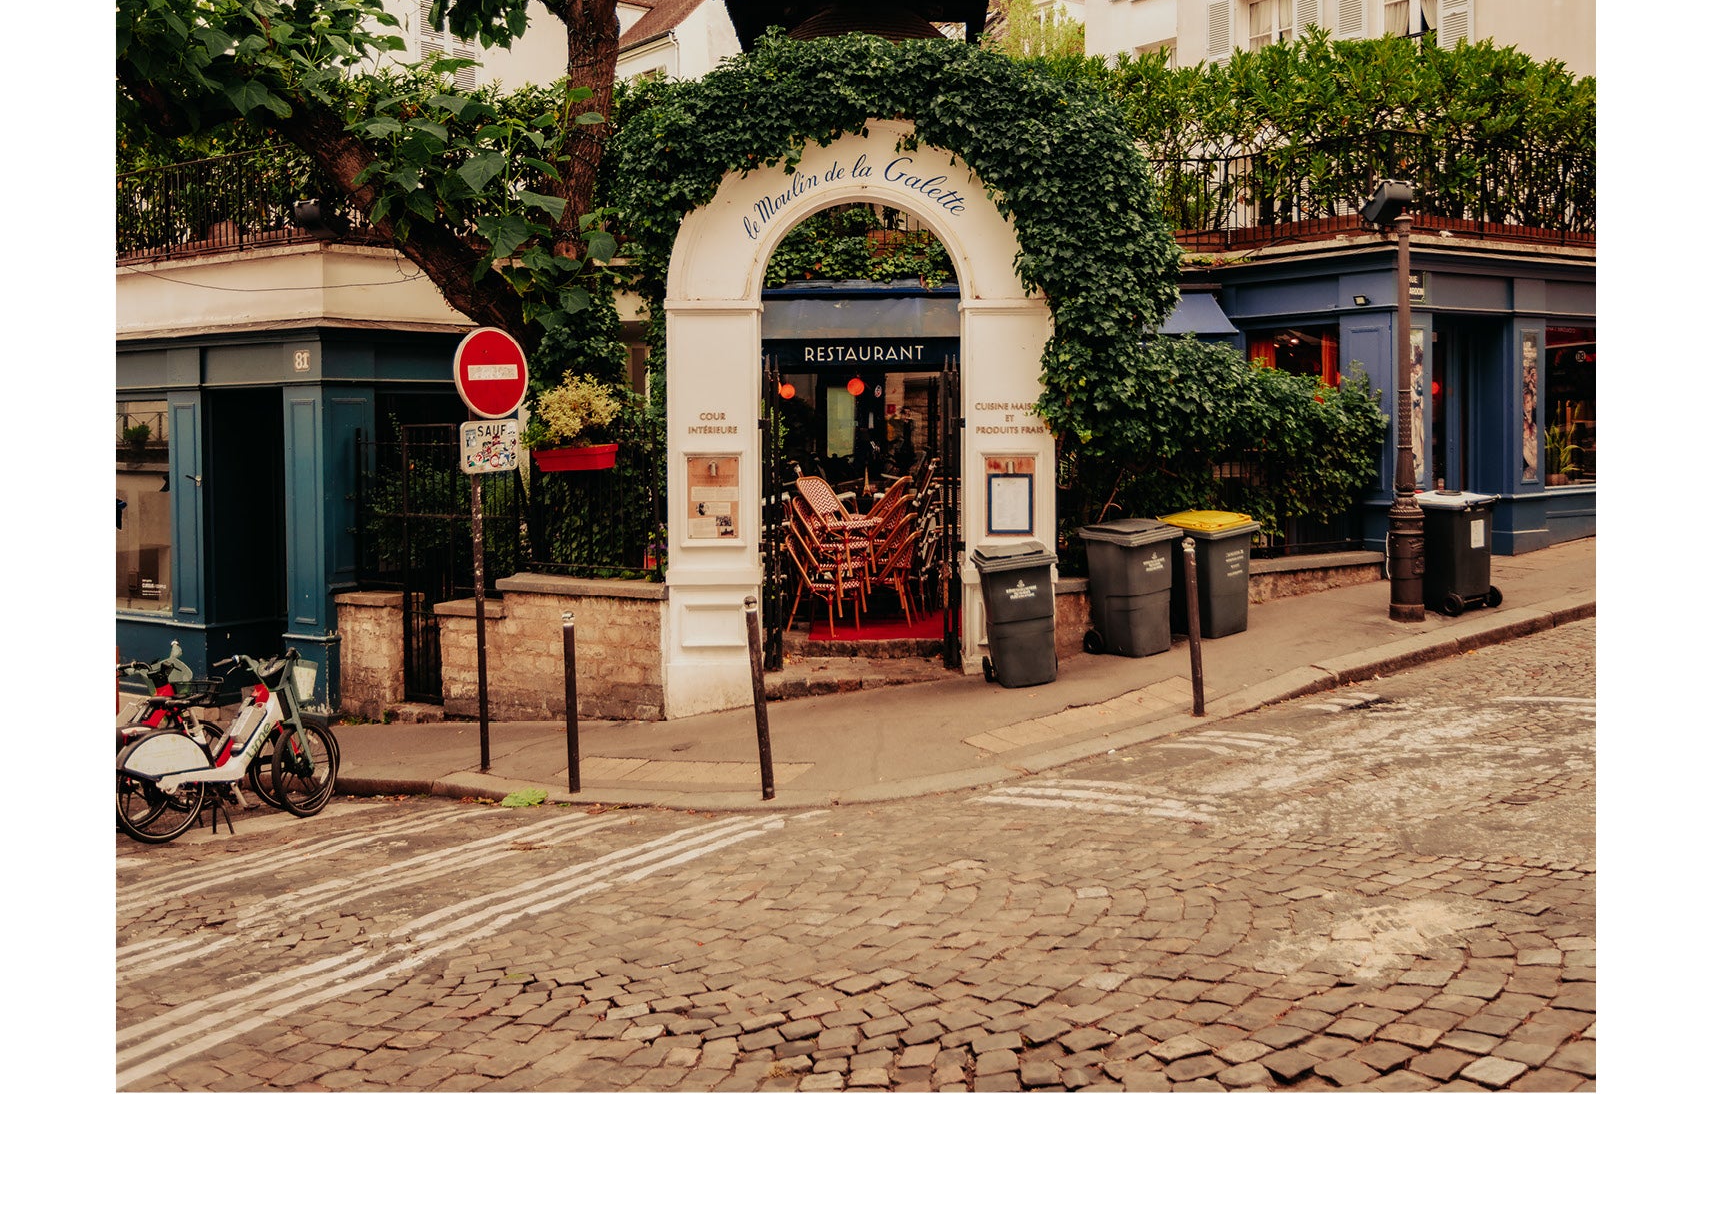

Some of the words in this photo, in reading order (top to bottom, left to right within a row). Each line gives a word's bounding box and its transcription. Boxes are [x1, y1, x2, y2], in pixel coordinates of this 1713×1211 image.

[743, 216, 760, 240] le
[753, 171, 820, 223] Moulin
[824, 160, 846, 183] de
[851, 153, 873, 178] la
[884, 156, 966, 217] Galette
[804, 345, 924, 362] RESTAURANT
[295, 352, 310, 370] 81
[975, 402, 1009, 411] CUISINE
[1011, 402, 1034, 411] MAIS
[699, 412, 727, 421] COUR
[1005, 414, 1015, 422] ET
[477, 425, 506, 437] SAUF
[688, 425, 738, 435] INTÉRIEURE
[975, 426, 1019, 434] PRODUITS
[1021, 426, 1044, 434] FRAIS
